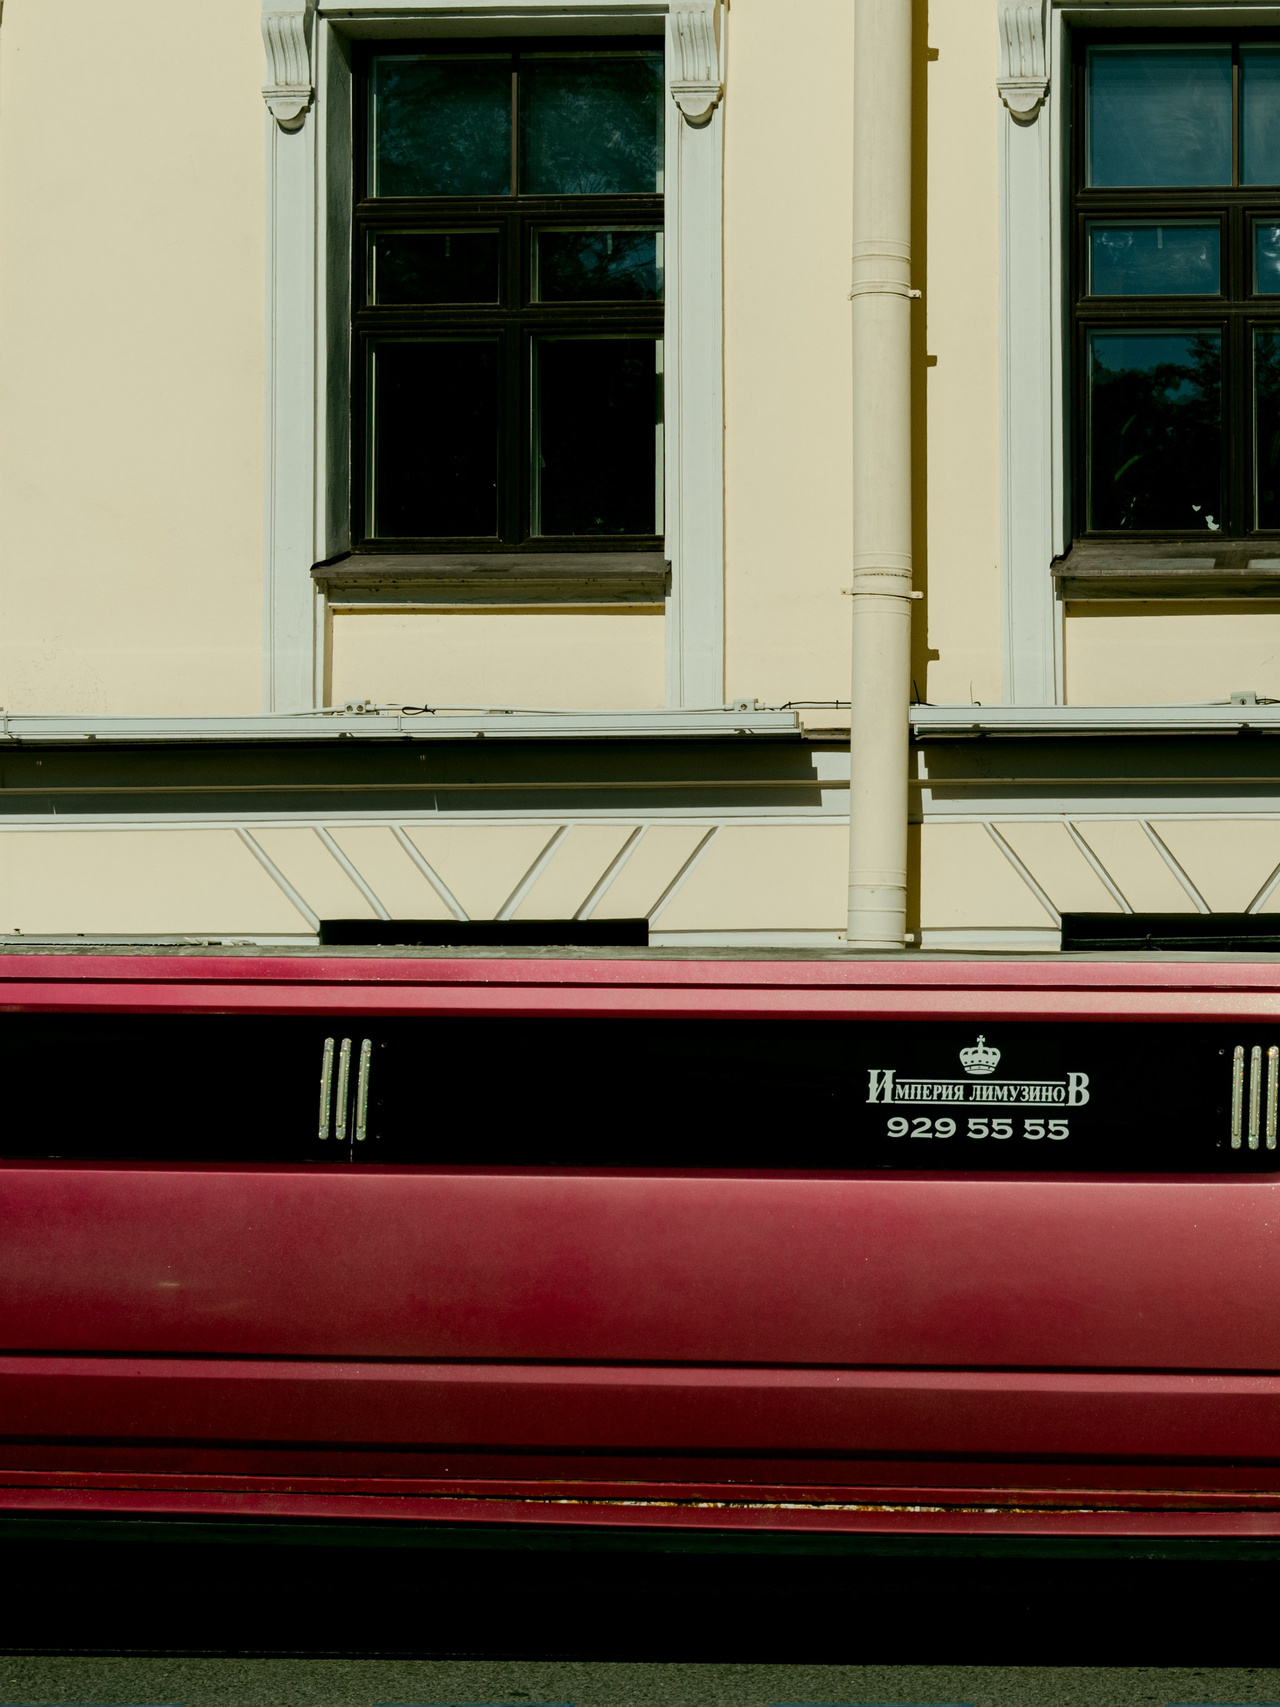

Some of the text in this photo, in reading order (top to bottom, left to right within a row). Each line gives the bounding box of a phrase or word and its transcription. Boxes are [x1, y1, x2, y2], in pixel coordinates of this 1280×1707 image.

[887, 1117, 1070, 1140] 929 55 55
